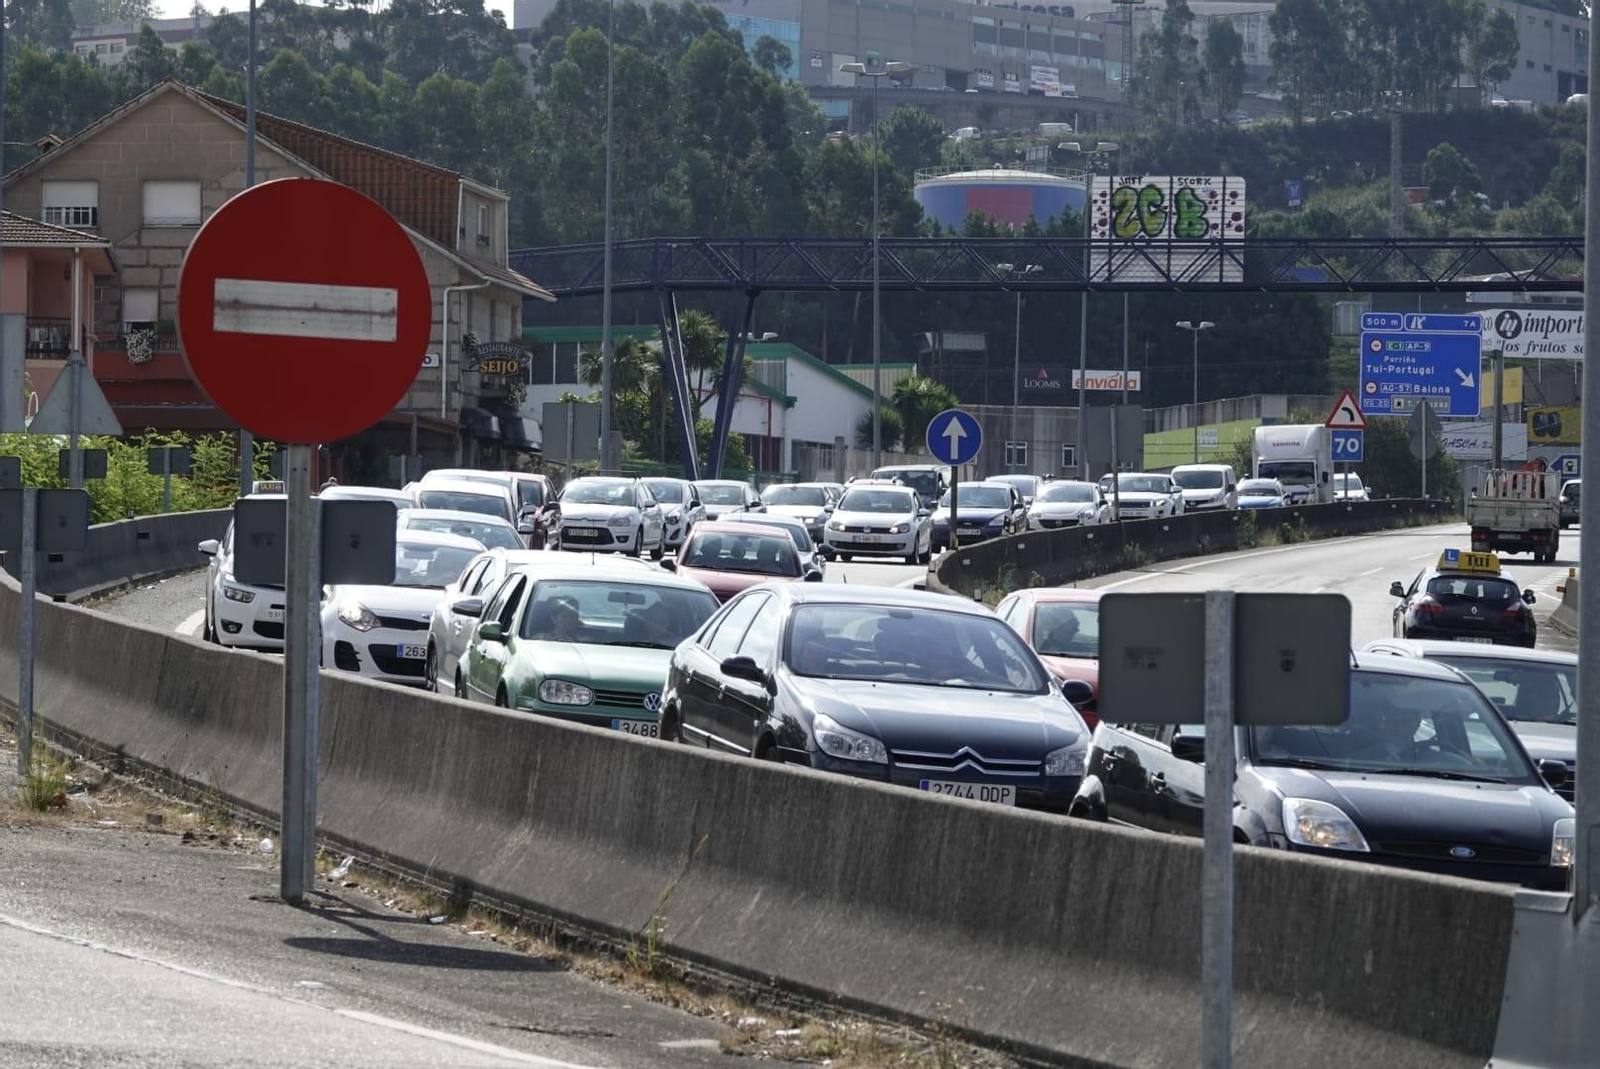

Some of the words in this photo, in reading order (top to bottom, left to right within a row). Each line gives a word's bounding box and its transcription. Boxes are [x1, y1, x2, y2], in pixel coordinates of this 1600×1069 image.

[1366, 316, 1386, 326] 500
[1523, 340, 1567, 356] frutos
[480, 360, 518, 375] SEIJO
[1366, 364, 1435, 376] Tui-Portugal
[1024, 377, 1061, 389] LOOMIS
[1381, 384, 1411, 393] AG-57
[1413, 384, 1451, 394] Baiona
[1333, 438, 1360, 454] 70
[1447, 551, 1456, 560] L
[405, 646, 426, 657] 263
[622, 721, 659, 738] 3488
[980, 786, 1011, 803] DDP
